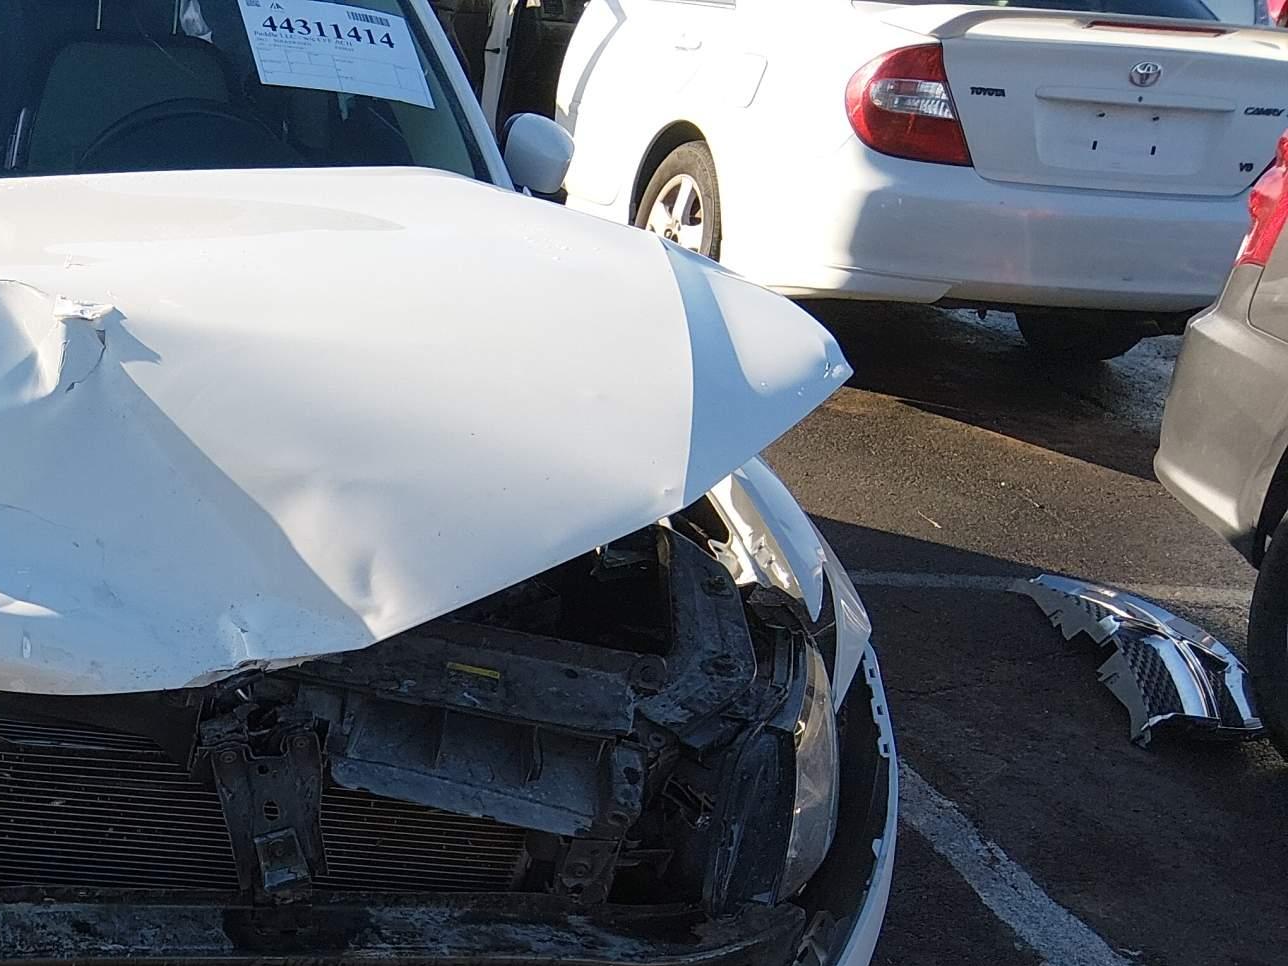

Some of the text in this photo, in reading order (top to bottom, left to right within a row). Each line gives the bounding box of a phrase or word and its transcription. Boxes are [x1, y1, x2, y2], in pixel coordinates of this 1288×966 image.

[262, 15, 395, 48] 44311414
[970, 86, 1006, 97] TOYOTA
[1240, 162, 1254, 172] V6
